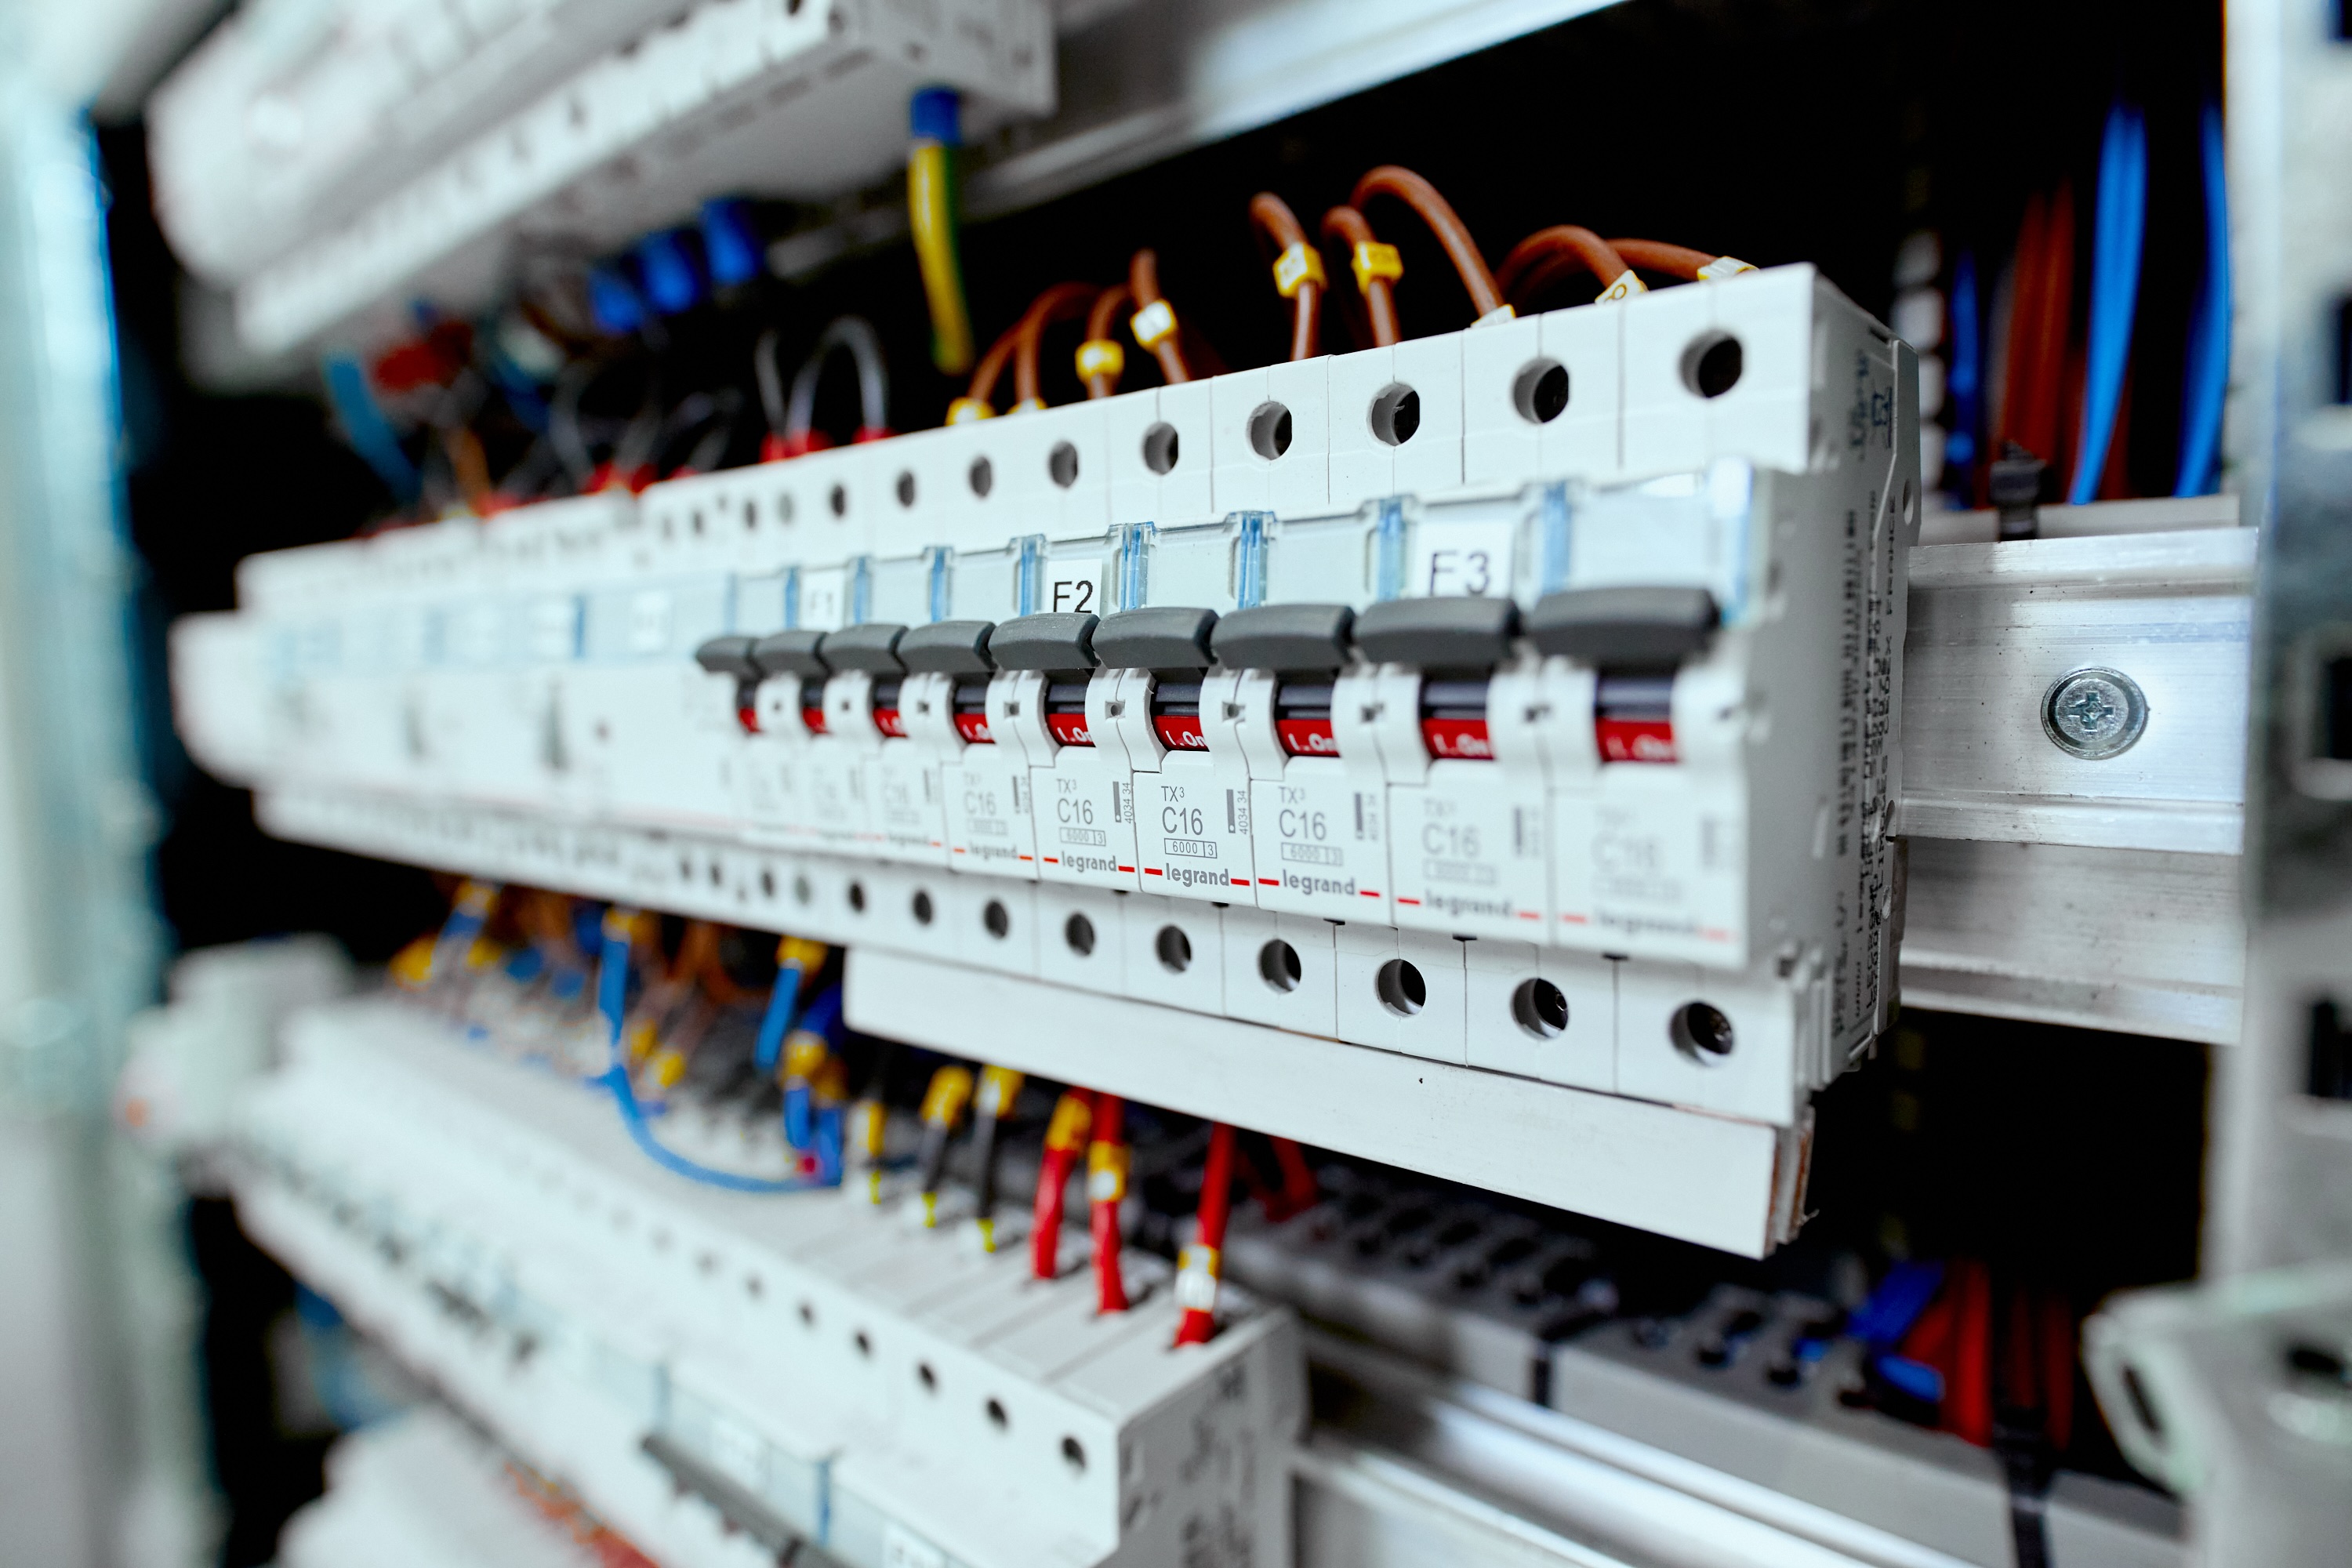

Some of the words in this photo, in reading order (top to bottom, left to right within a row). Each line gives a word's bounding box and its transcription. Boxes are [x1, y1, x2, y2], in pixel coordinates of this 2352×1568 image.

[1429, 550, 1490, 596] F3
[1053, 580, 1093, 613] F2
[1122, 782, 1131, 795] 34
[1237, 790, 1247, 803] 34
[1057, 798, 1093, 825] C16
[1123, 799, 1134, 824] 4034
[1162, 806, 1203, 835] C16
[1238, 808, 1248, 835] 4034
[1279, 809, 1327, 840] C16
[1172, 840, 1198, 854] 6000
[1207, 844, 1214, 855] 3
[1061, 851, 1117, 873] legrand
[1166, 862, 1229, 887] legrand
[1283, 869, 1356, 895] legrand
